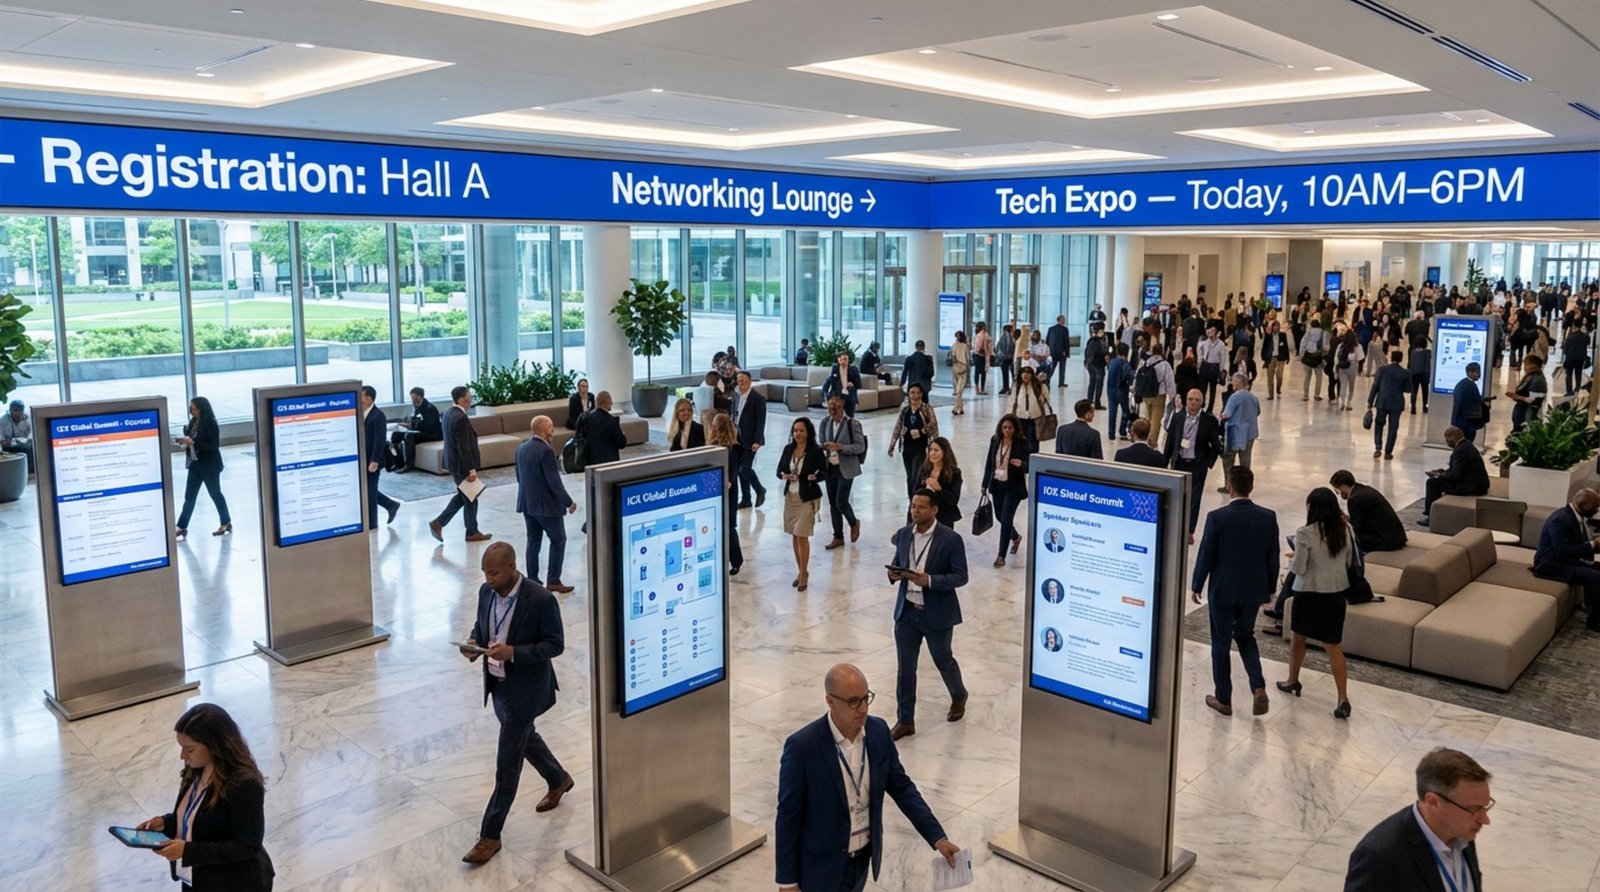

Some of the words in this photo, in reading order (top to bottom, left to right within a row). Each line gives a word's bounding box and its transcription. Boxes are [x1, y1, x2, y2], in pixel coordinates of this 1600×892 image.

[42, 137, 366, 199] Registration:
[381, 157, 451, 197] Hall
[463, 162, 490, 199] A
[611, 171, 765, 217] Networking
[772, 181, 854, 219] Lounge
[995, 187, 1057, 215] Tech
[1065, 185, 1137, 219] Expo
[1186, 178, 1289, 216] Today,
